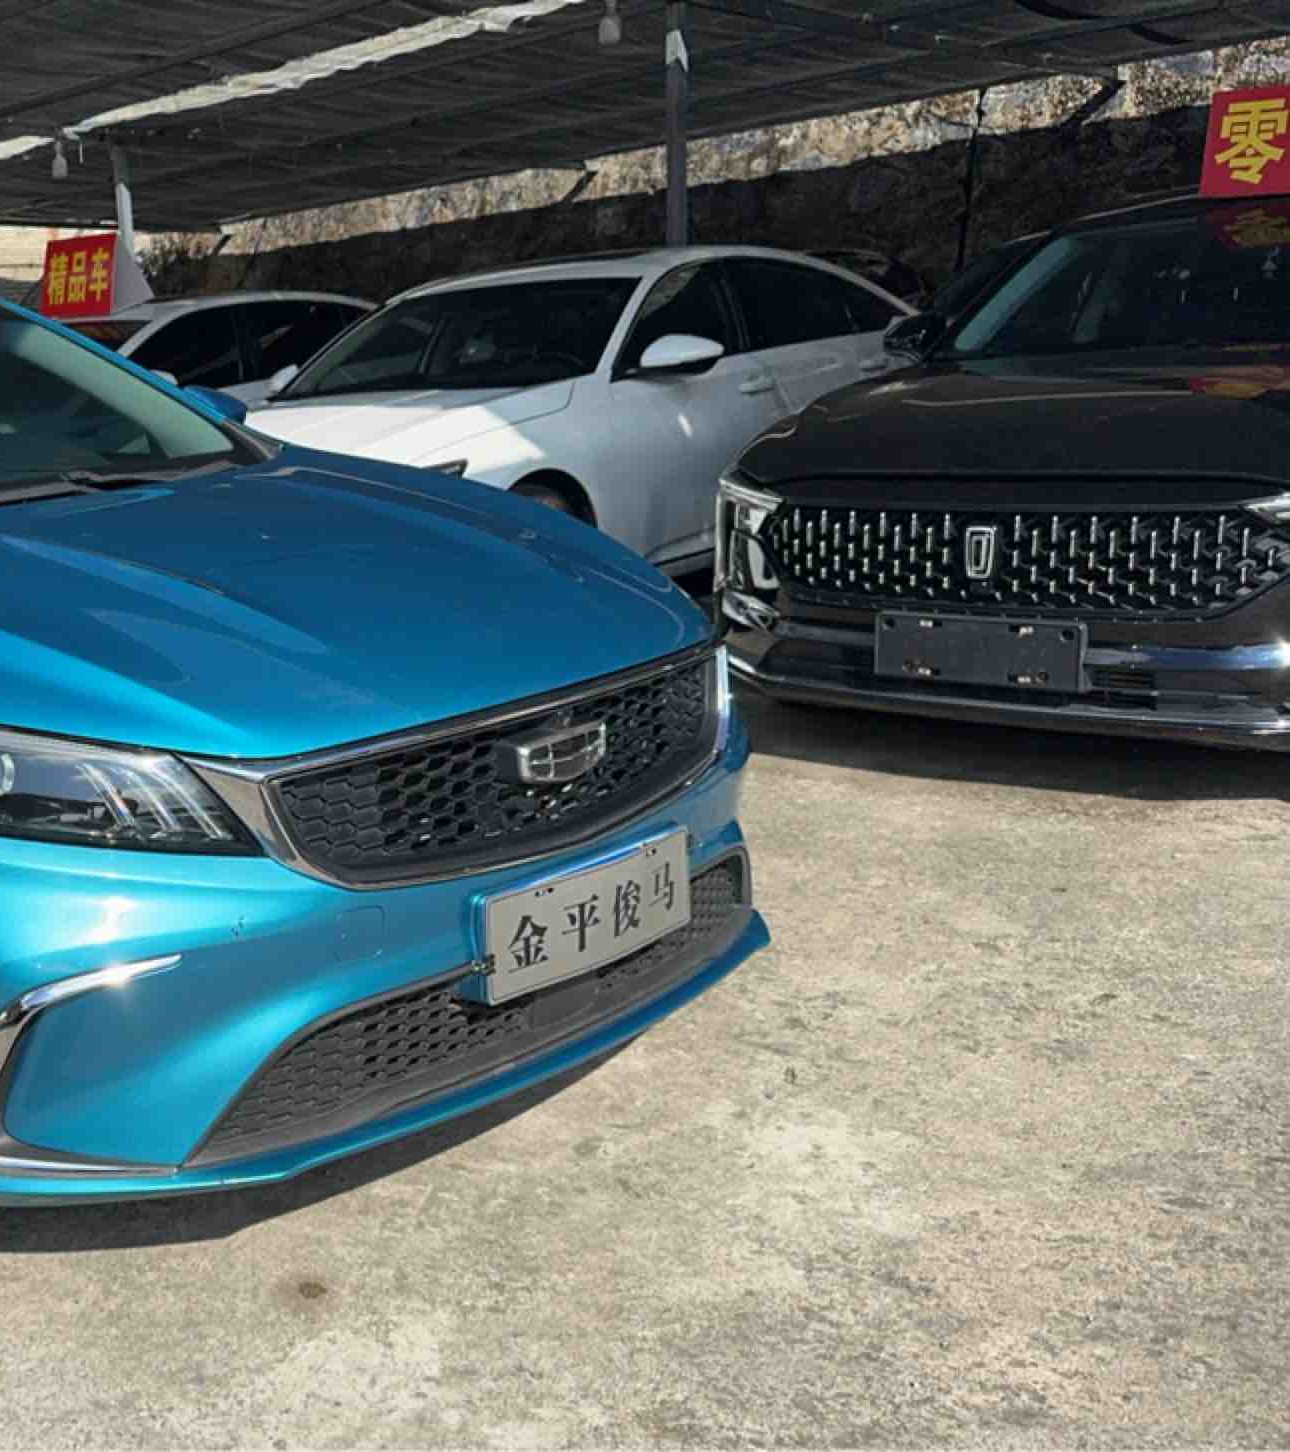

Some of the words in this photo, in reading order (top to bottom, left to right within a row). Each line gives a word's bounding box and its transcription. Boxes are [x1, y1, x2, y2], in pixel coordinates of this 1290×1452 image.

[1213, 98, 1289, 184] 零
[47, 248, 110, 305] 精品车
[508, 861, 675, 975] 金平俊马
